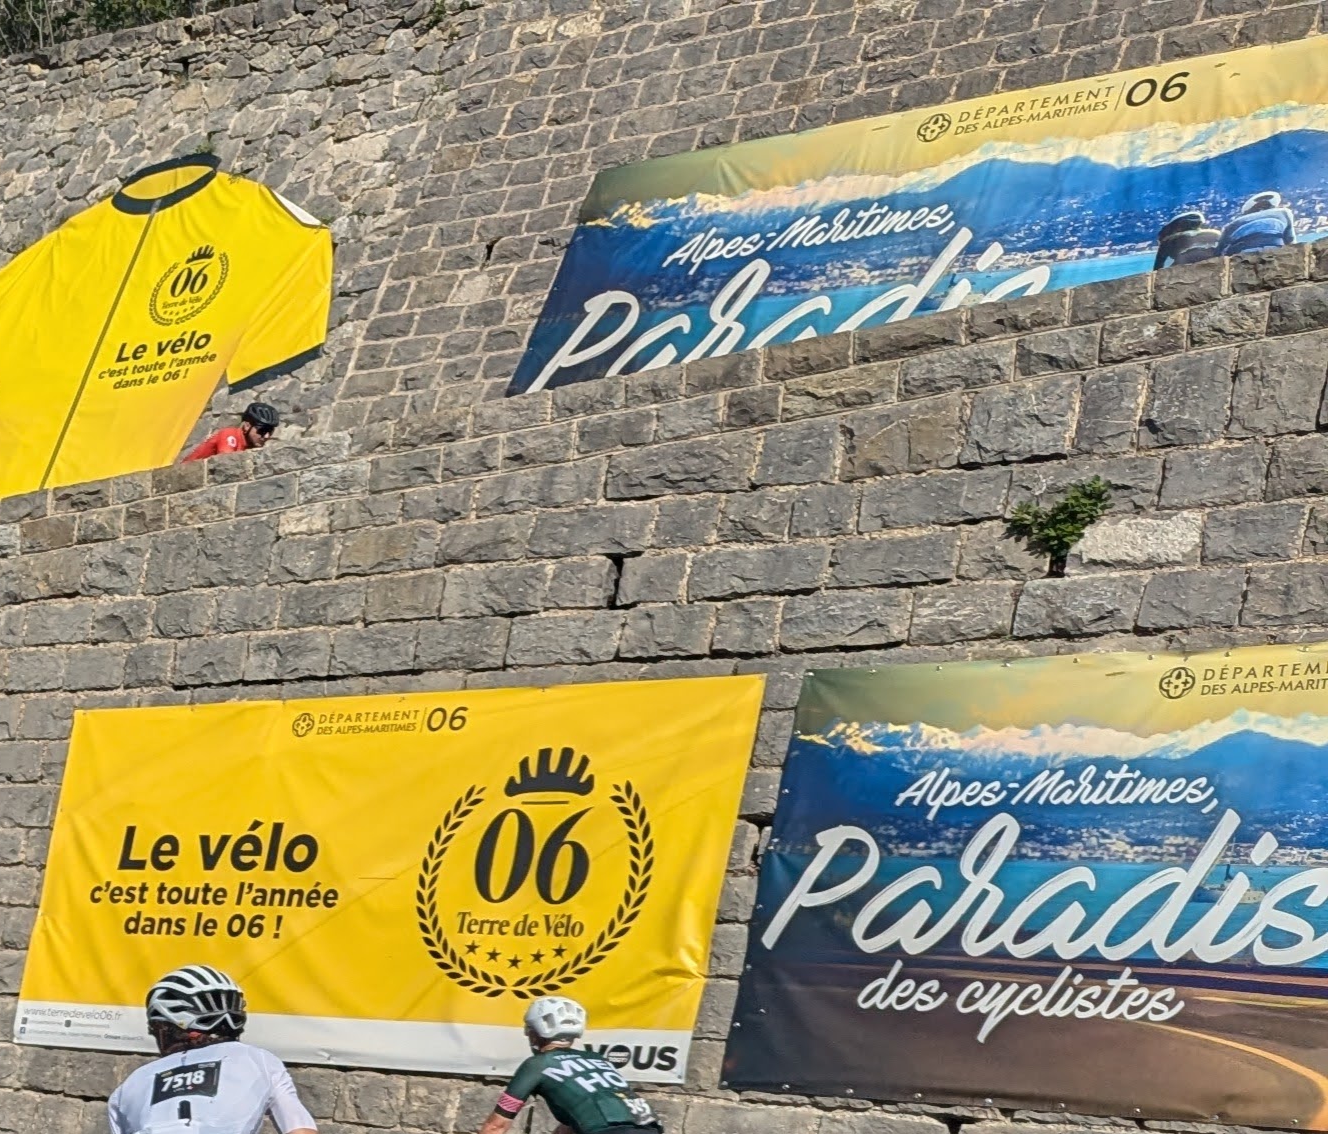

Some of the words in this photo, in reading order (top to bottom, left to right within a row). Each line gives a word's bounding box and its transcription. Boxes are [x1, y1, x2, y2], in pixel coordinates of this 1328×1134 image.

[957, 86, 1115, 123] DÉPARTEMENT
[1125, 71, 1191, 107] 06
[954, 123, 978, 136] DES
[982, 100, 1109, 130] ALPES-MARITIMES
[662, 203, 956, 275] Alpes-Maritimes,
[170, 262, 213, 298] 06
[115, 342, 148, 363] Le
[157, 330, 212, 357] vélo
[98, 366, 129, 380] c'est
[131, 360, 166, 375] toute
[168, 351, 217, 368] l'année
[113, 376, 145, 390] dans
[146, 373, 159, 385] le
[162, 370, 181, 381] 06
[1203, 662, 1328, 681] DÉPARTEM
[1200, 684, 1227, 696] DES
[316, 725, 333, 736] DES
[318, 709, 420, 725] DÉPARTEMENT
[426, 706, 469, 732] 06
[895, 762, 1219, 821] Alpes-Maritimes,
[117, 825, 180, 871] Le
[199, 819, 319, 873] vélo
[474, 806, 595, 905] 06
[89, 881, 148, 905] c'est
[156, 881, 228, 906] toute
[235, 881, 339, 908] l'année
[761, 808, 1328, 966] Paradis
[124, 911, 187, 936] dans
[193, 911, 218, 937] le
[226, 913, 265, 939] 06
[456, 911, 510, 936] Terre
[513, 913, 539, 937] de
[542, 912, 584, 938] Vélo
[856, 958, 948, 1013] des
[955, 966, 1185, 1044] cyclistes
[161, 1070, 205, 1092] 7518
